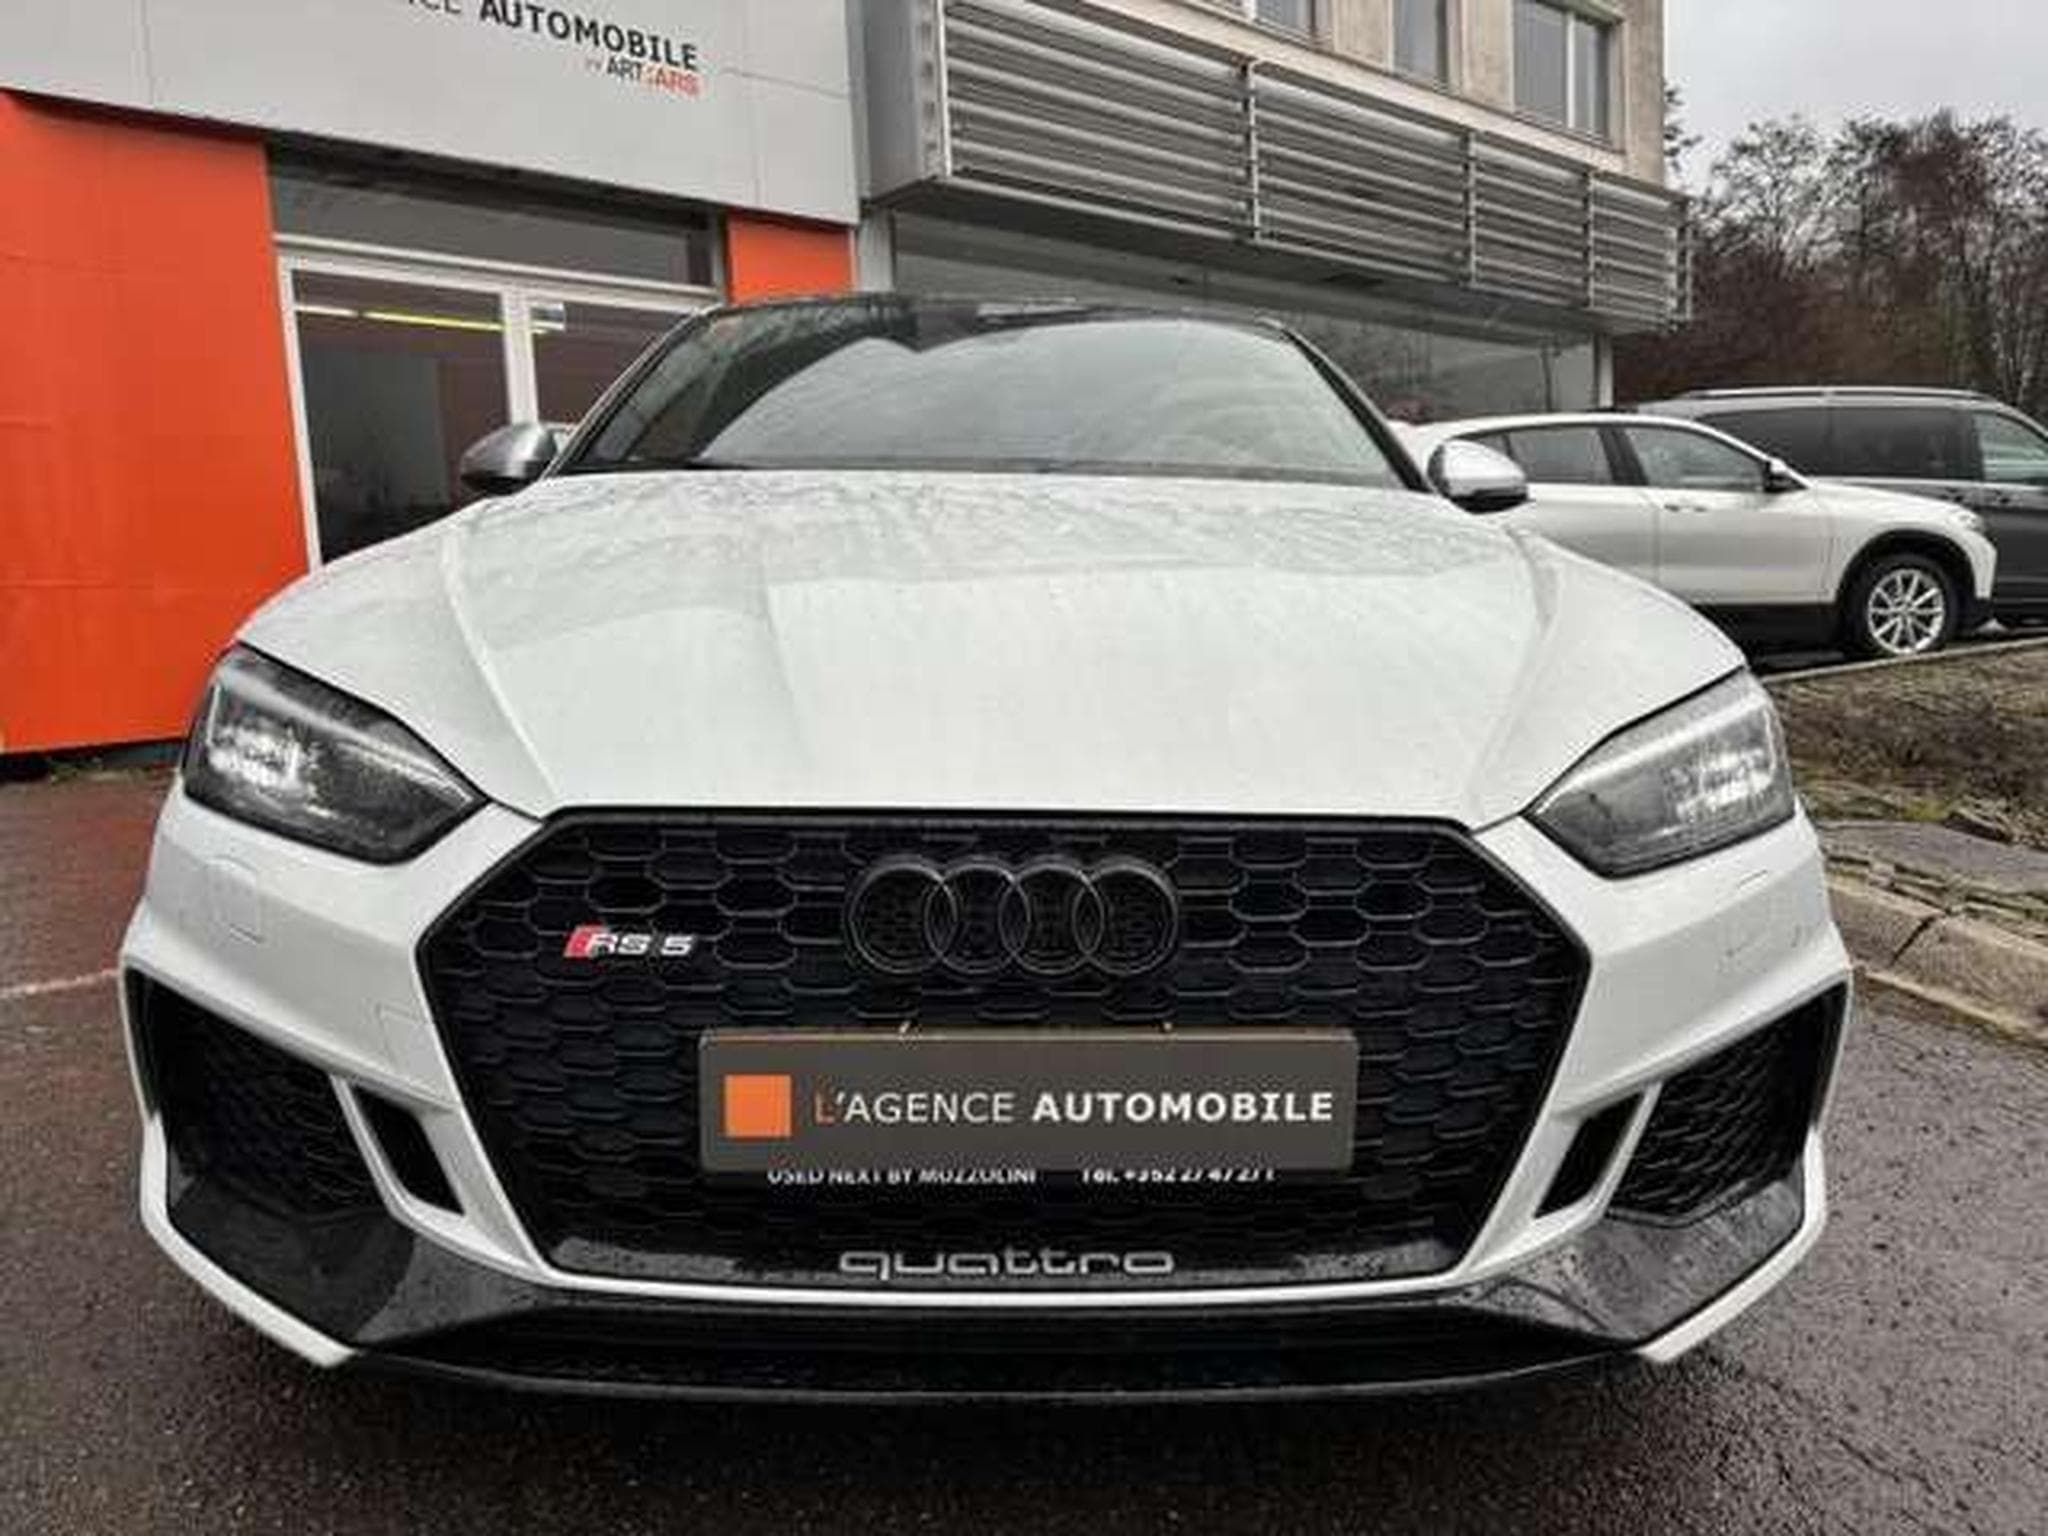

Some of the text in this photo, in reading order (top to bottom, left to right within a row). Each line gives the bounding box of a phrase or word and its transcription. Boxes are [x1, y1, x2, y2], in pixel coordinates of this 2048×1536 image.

[479, 0, 698, 71] AUTOMOBILE
[584, 933, 694, 958] RS 5
[813, 1091, 1334, 1123] L'AGENCE AUTOMOBILE
[766, 1167, 825, 1185] USED
[828, 1167, 882, 1184] NEXT
[838, 1248, 1175, 1281] quattro
